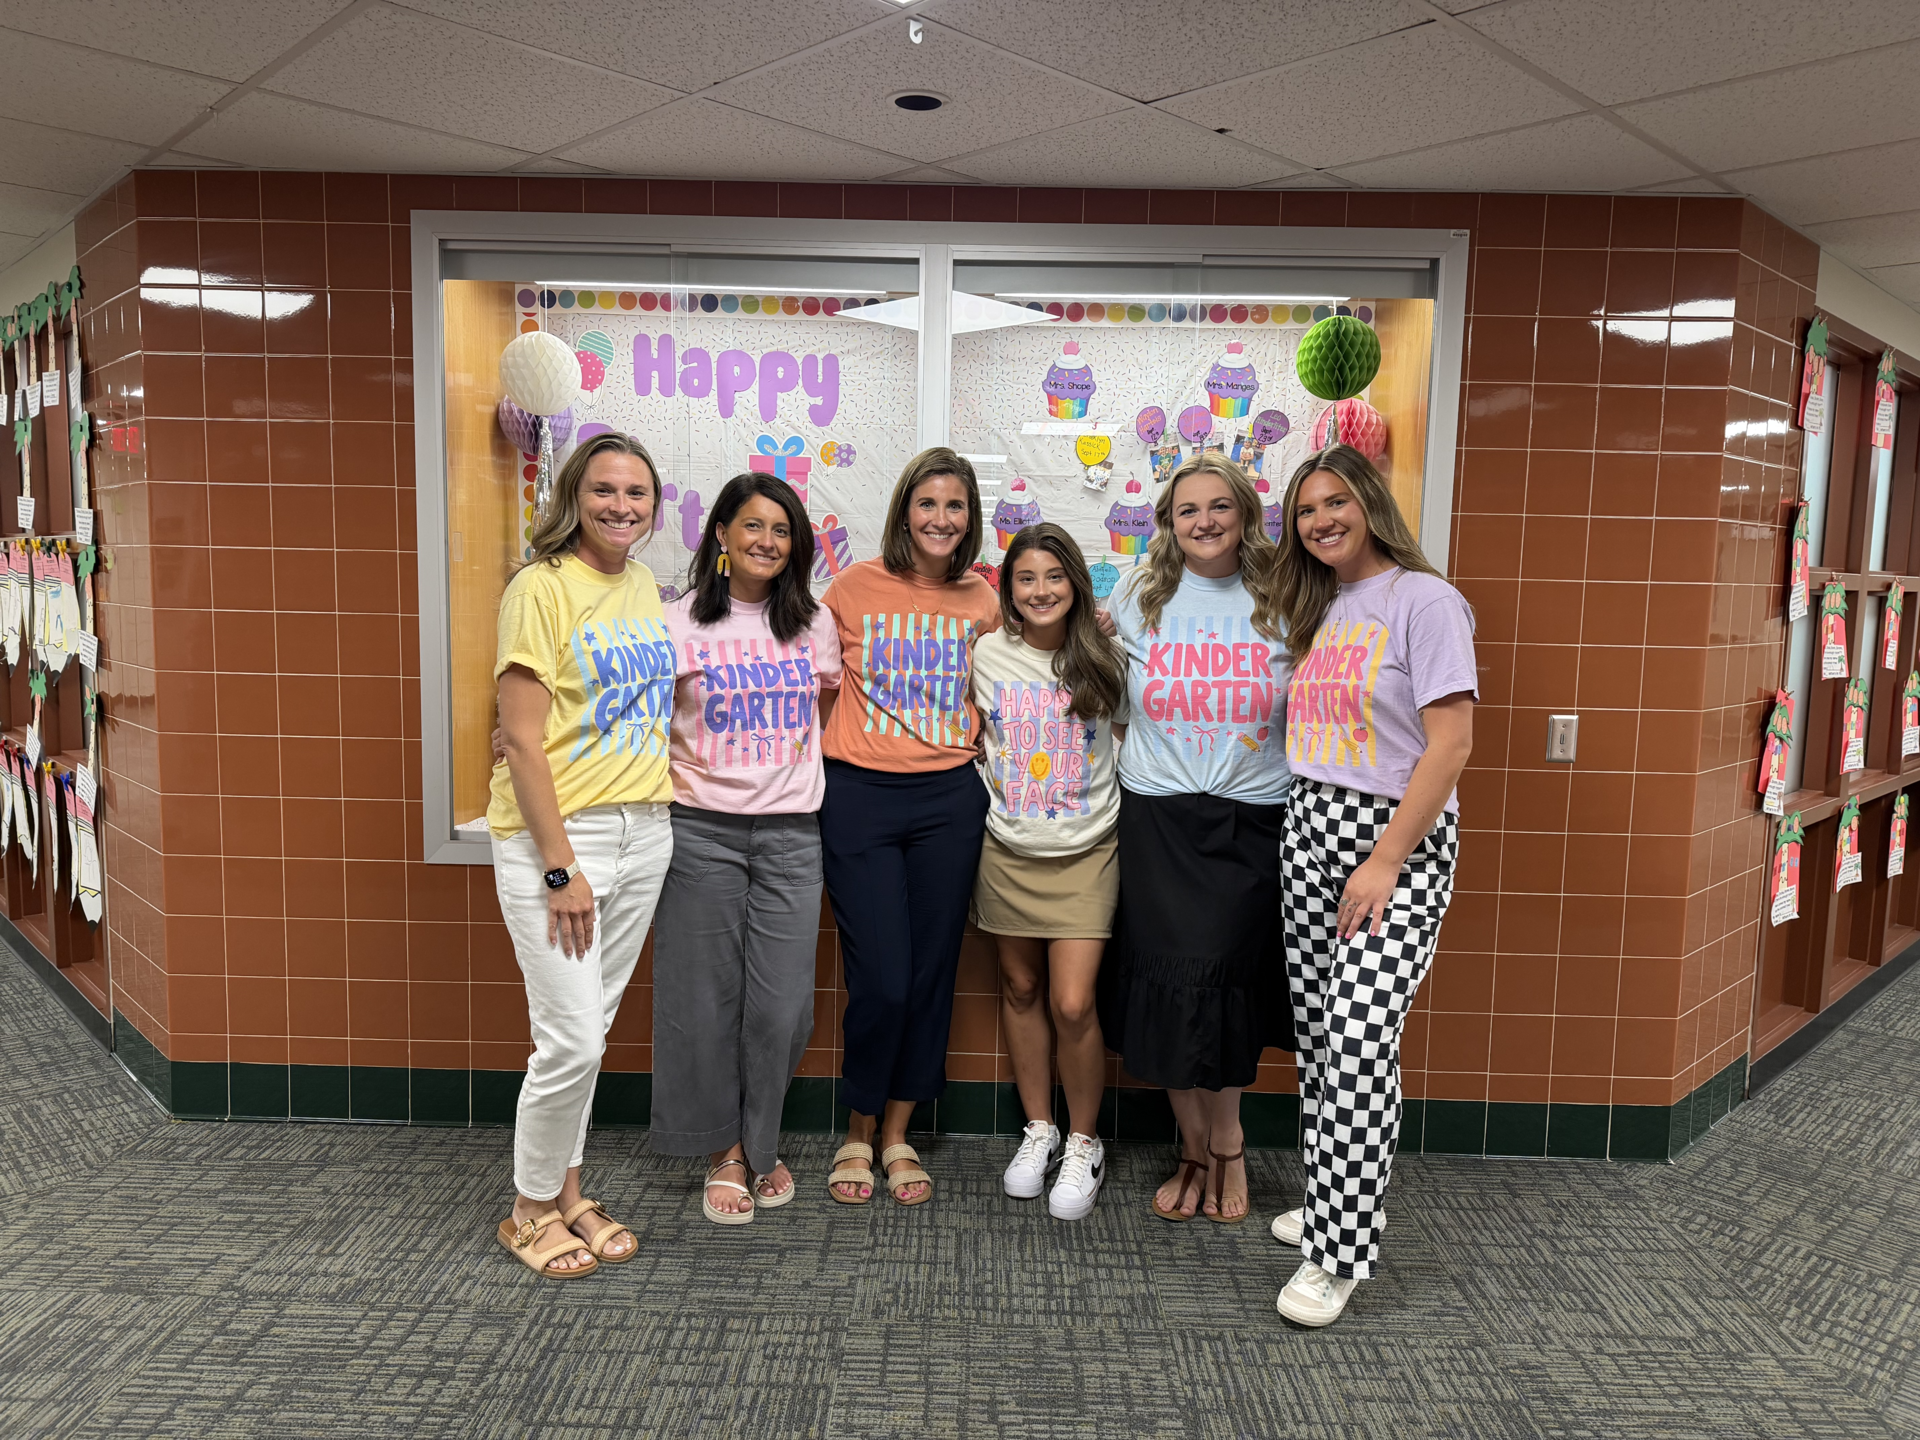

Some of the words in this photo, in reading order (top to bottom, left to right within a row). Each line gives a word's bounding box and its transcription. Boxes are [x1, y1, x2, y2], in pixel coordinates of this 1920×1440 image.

[633, 333, 839, 427] Happy
[1049, 381, 1065, 390] Mrs.
[1068, 382, 1091, 391] Shope
[1207, 381, 1224, 390] Mrs.
[1226, 382, 1255, 392] Manges
[1270, 411, 1281, 421] Leo
[1000, 517, 1012, 525] Ms.
[1113, 519, 1130, 527] Mrs.
[1131, 519, 1149, 527] Klein
[591, 639, 678, 689] KINDER
[871, 636, 969, 673] KINDER
[1146, 641, 1273, 679] KINDER
[1293, 643, 1368, 681] INDER
[703, 658, 815, 692] KINDER
[869, 673, 966, 712] GARTEN
[1000, 688, 1078, 720] HAPP
[1142, 679, 1274, 724] GARTEN
[704, 690, 815, 734] GARTEN
[1003, 721, 1037, 750] TO
[1042, 721, 1086, 750] SEE
[1006, 781, 1083, 812] FACE
